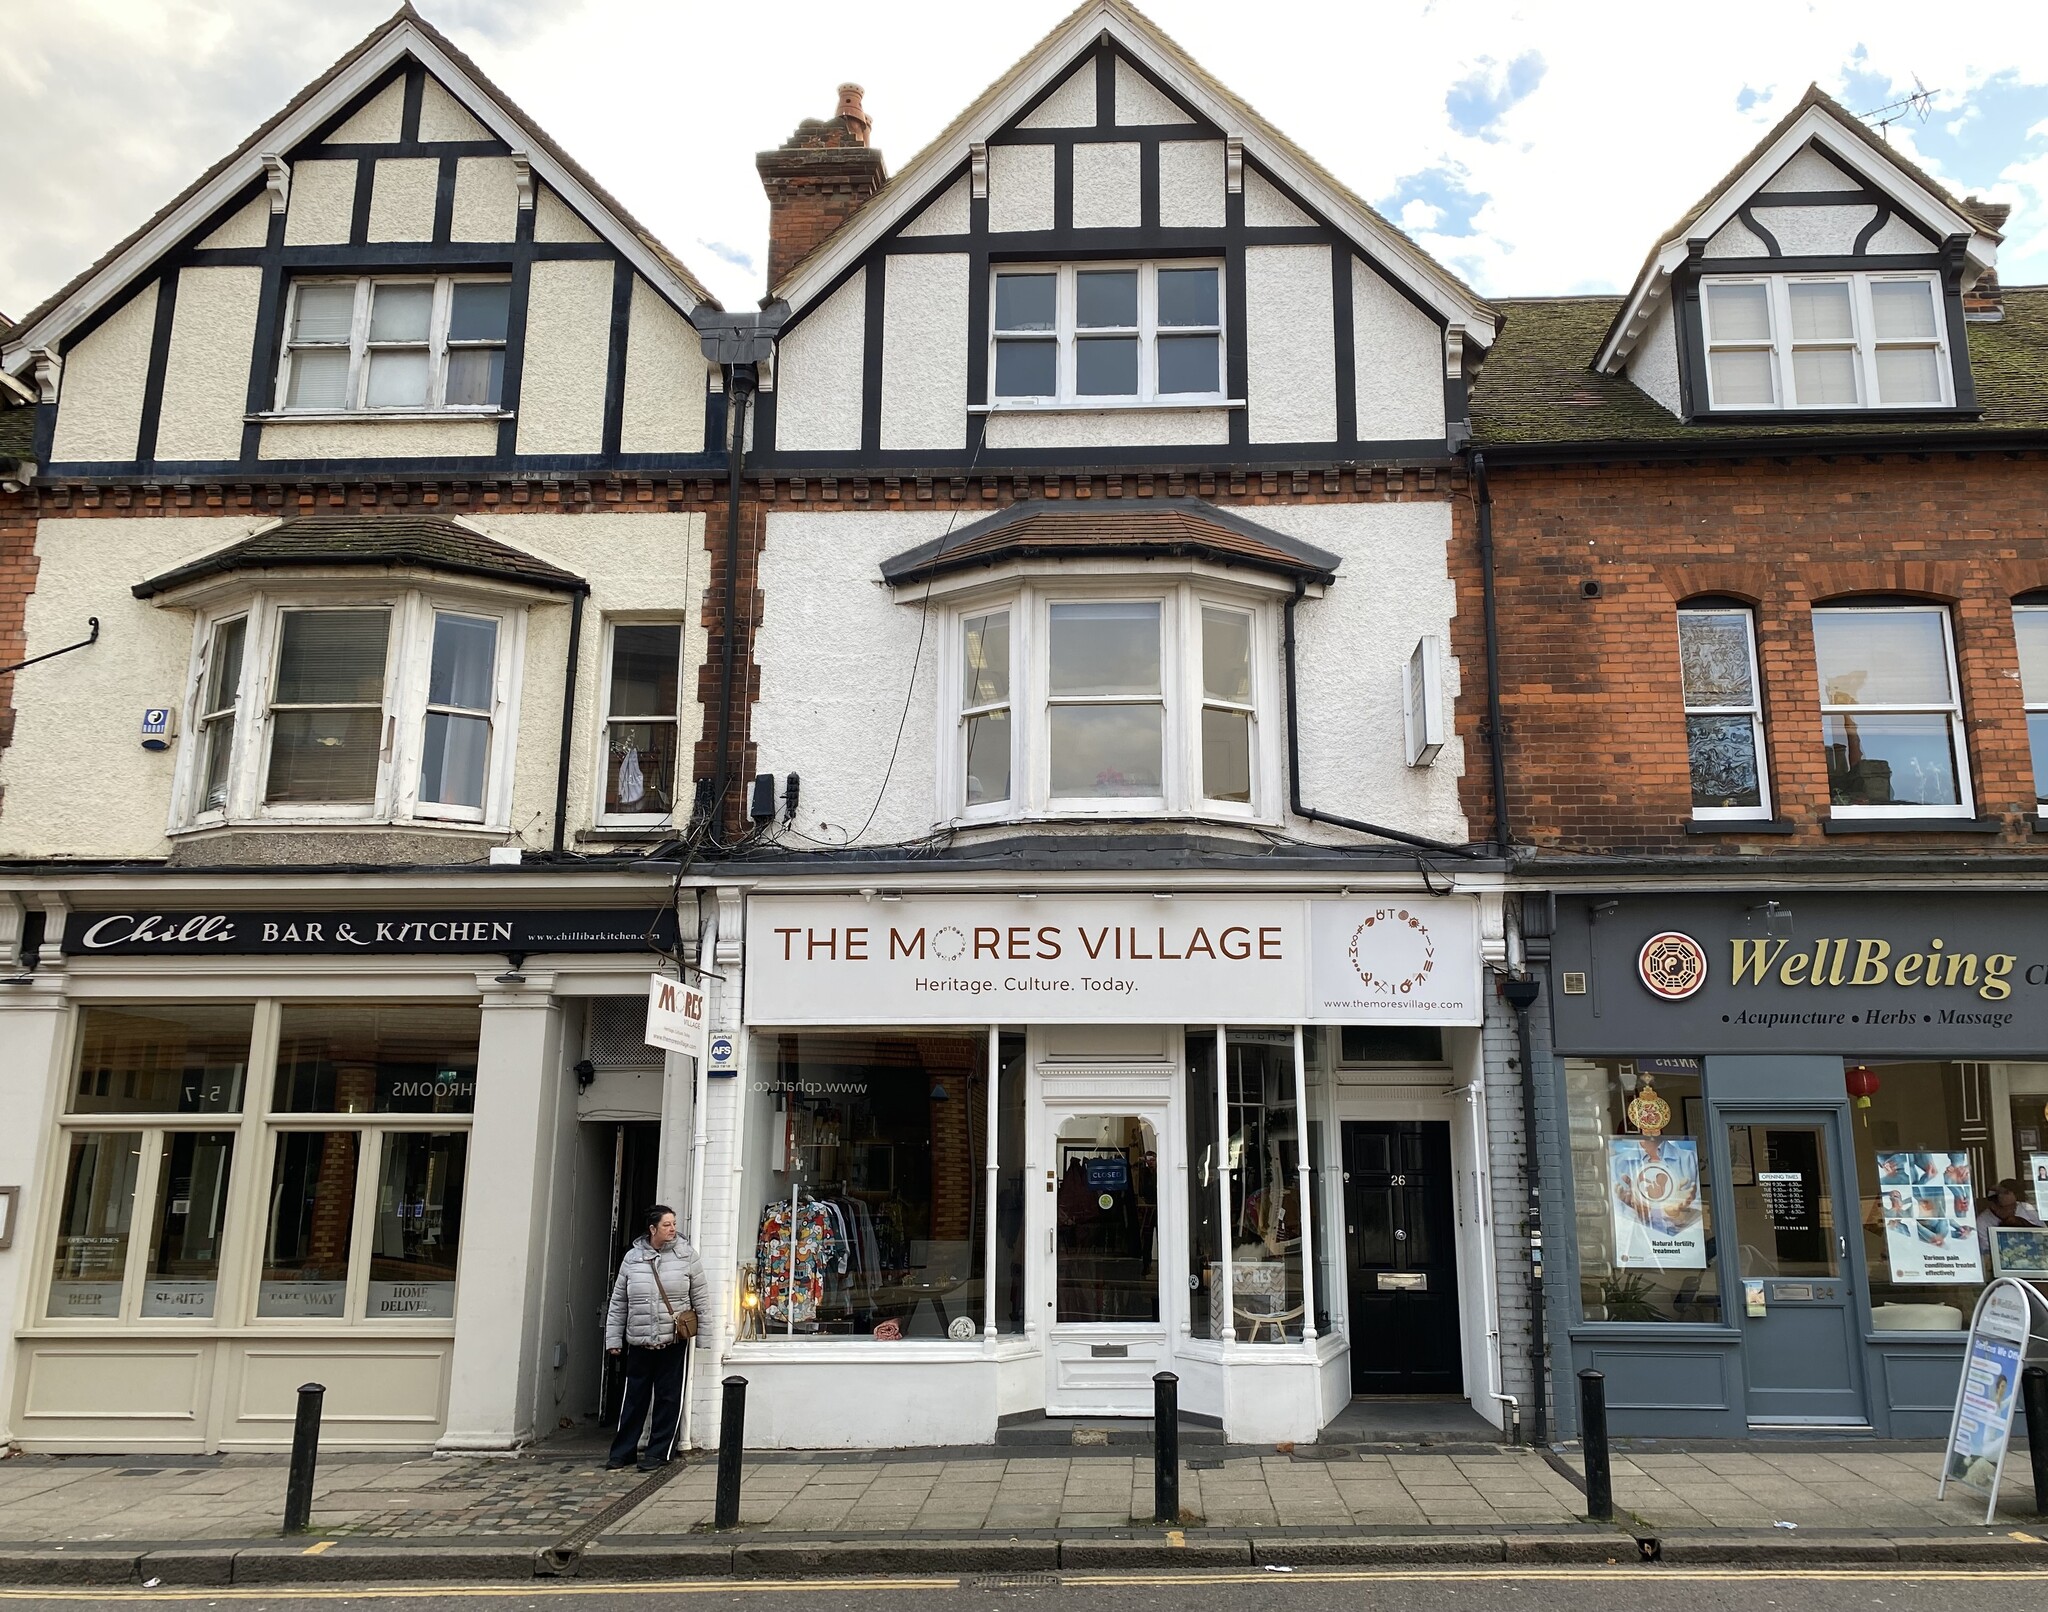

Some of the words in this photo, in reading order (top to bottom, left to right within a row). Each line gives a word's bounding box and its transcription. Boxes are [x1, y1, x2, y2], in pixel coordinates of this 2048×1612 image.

[82, 914, 236, 948] Chilli
[261, 922, 326, 942] BAR
[335, 922, 371, 945] &
[375, 922, 514, 942] KITCHEN
[527, 931, 661, 941] www.chillibarkitchen.cm
[773, 927, 869, 961] THE
[888, 925, 1063, 962] MORES
[1078, 926, 1284, 960] VILLAGE
[1729, 937, 2018, 1001] WellBeing
[914, 977, 998, 995] Heritage.
[1003, 977, 1075, 992] Culture.
[1081, 977, 1139, 995] Today.
[658, 983, 703, 1021] MORES
[1324, 1000, 1464, 1011] www.themoresvillage.com
[1734, 1009, 1846, 1028] Acupuncture
[1865, 1009, 1917, 1025] Herbs
[1937, 1009, 2014, 1029] Massage
[712, 1046, 731, 1055] AFS
[1092, 1171, 1122, 1179] CLOSED
[1390, 1174, 1406, 1186] 26
[1674, 1240, 1695, 1248] fertility
[1946, 1254, 1960, 1262] pain
[68, 1293, 102, 1305] BEER
[1816, 1286, 1835, 1300] 24
[380, 1300, 435, 1312] DELIVE
[1997, 1345, 2007, 1357] We
